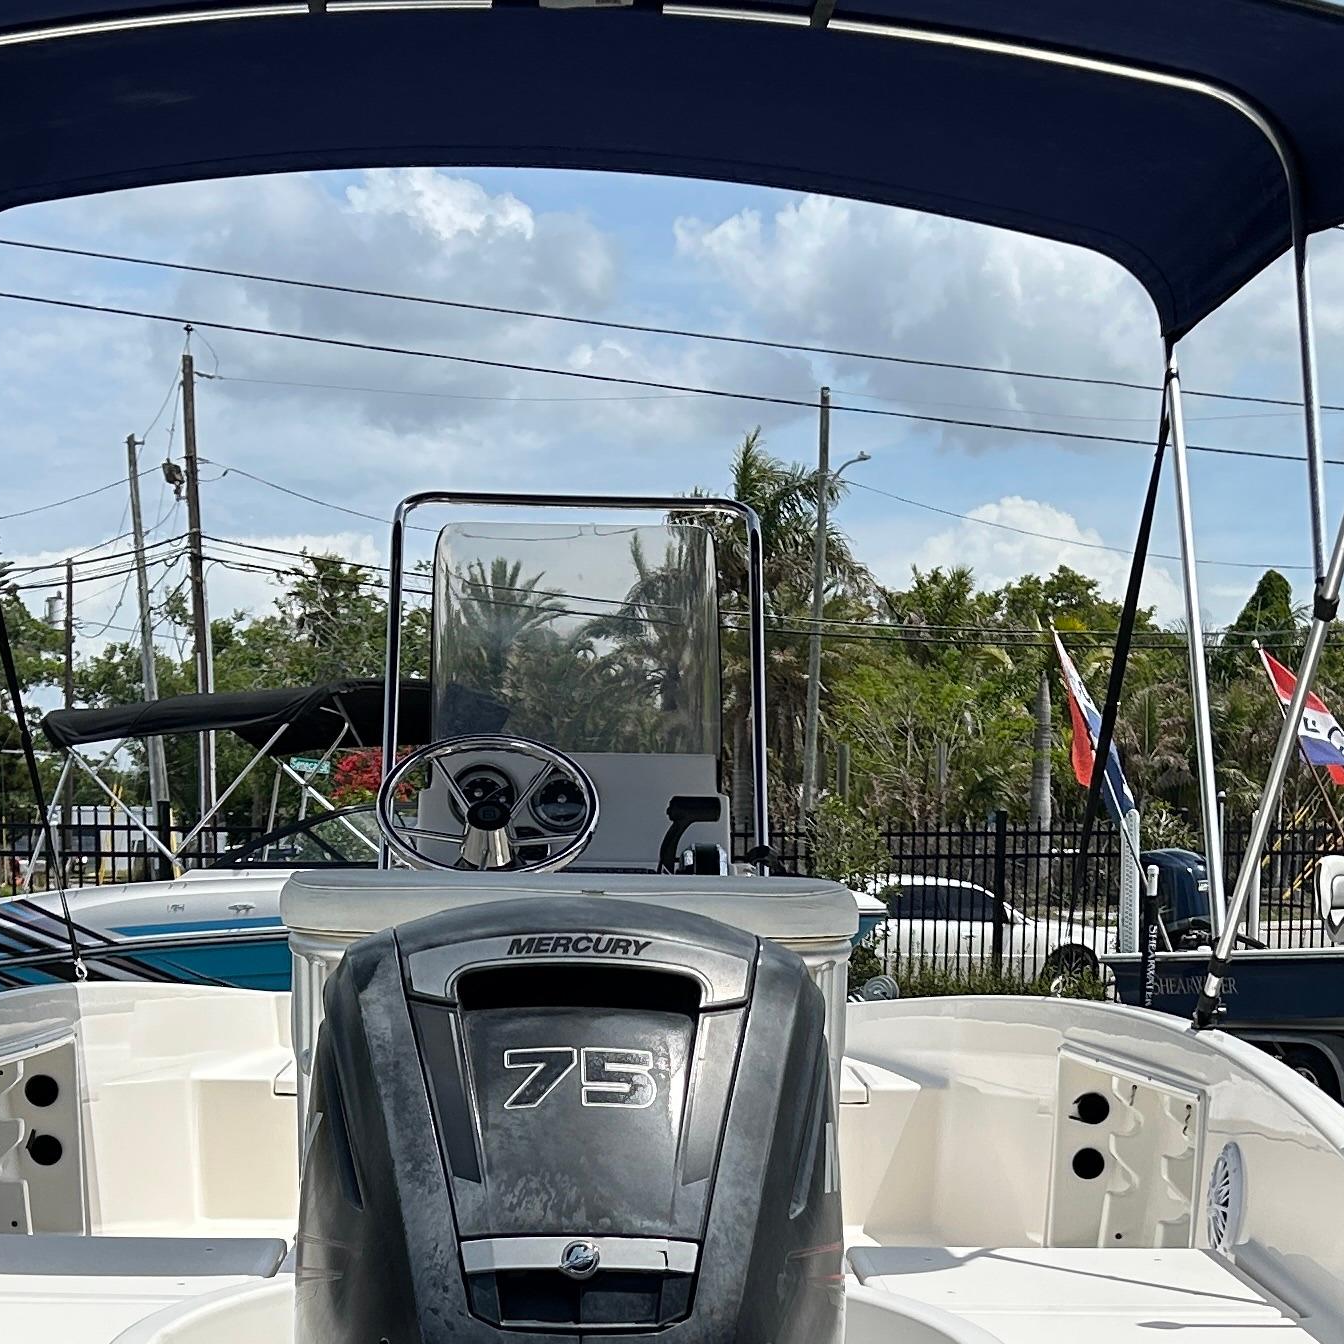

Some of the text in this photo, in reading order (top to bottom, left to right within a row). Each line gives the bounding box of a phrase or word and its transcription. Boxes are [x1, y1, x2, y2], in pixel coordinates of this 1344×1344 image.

[506, 935, 653, 956] MERCURY
[1144, 924, 1158, 1007] SHEARWATER
[504, 1047, 657, 1109] 75
